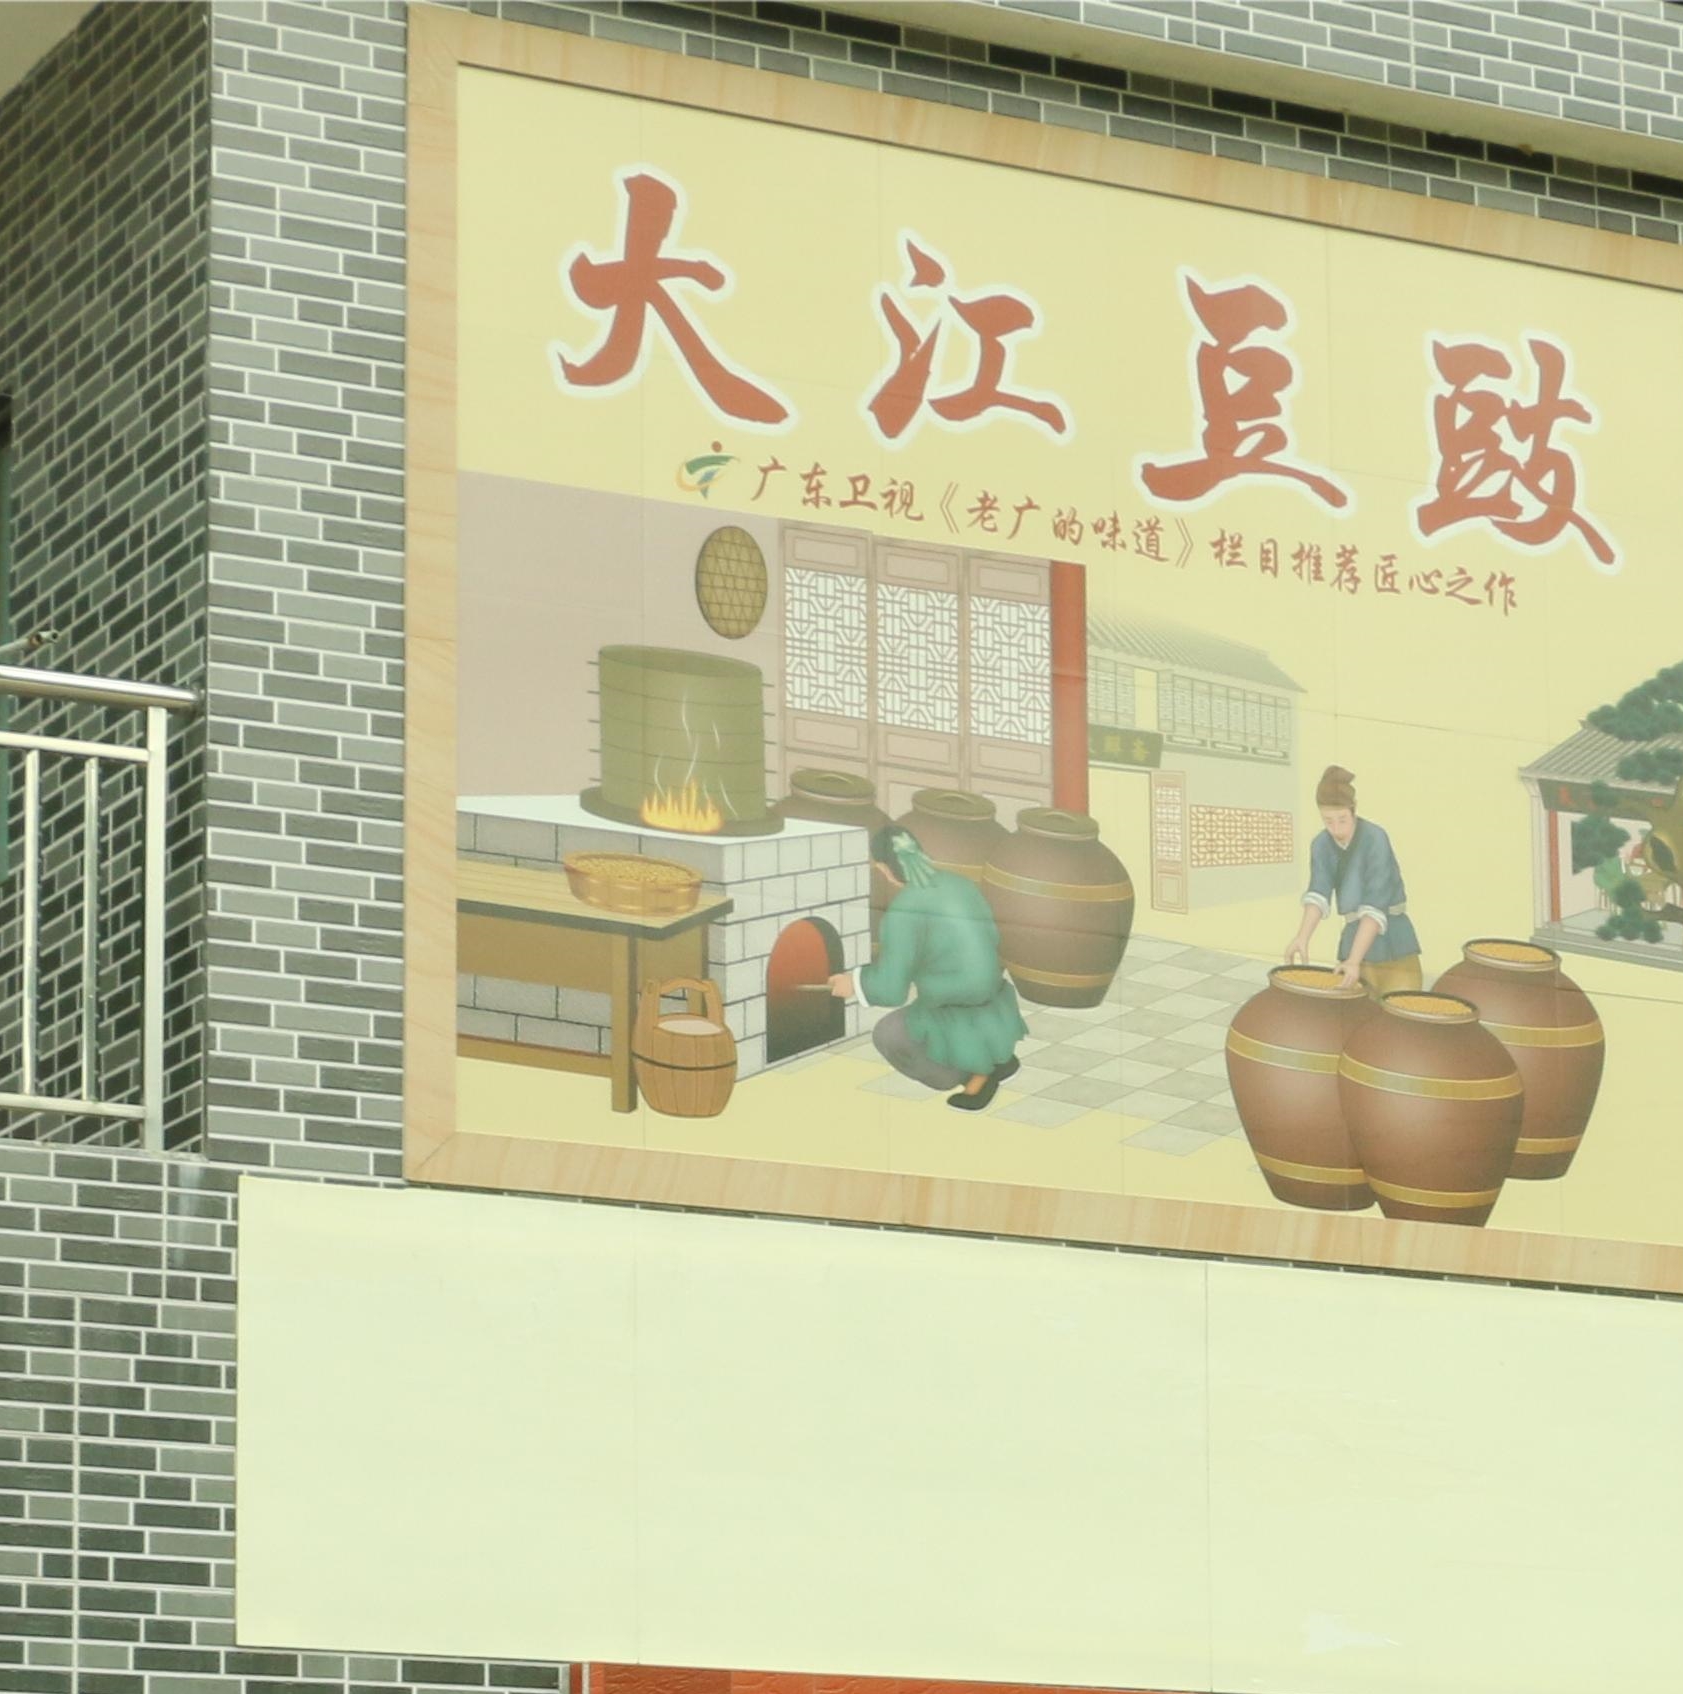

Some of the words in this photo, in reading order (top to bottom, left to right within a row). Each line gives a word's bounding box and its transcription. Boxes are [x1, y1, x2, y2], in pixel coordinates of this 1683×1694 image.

[557, 173, 1616, 564] 大江豆豉
[751, 456, 1518, 615] 广东卫视《老广的味道》栏目推荐匠心之作
